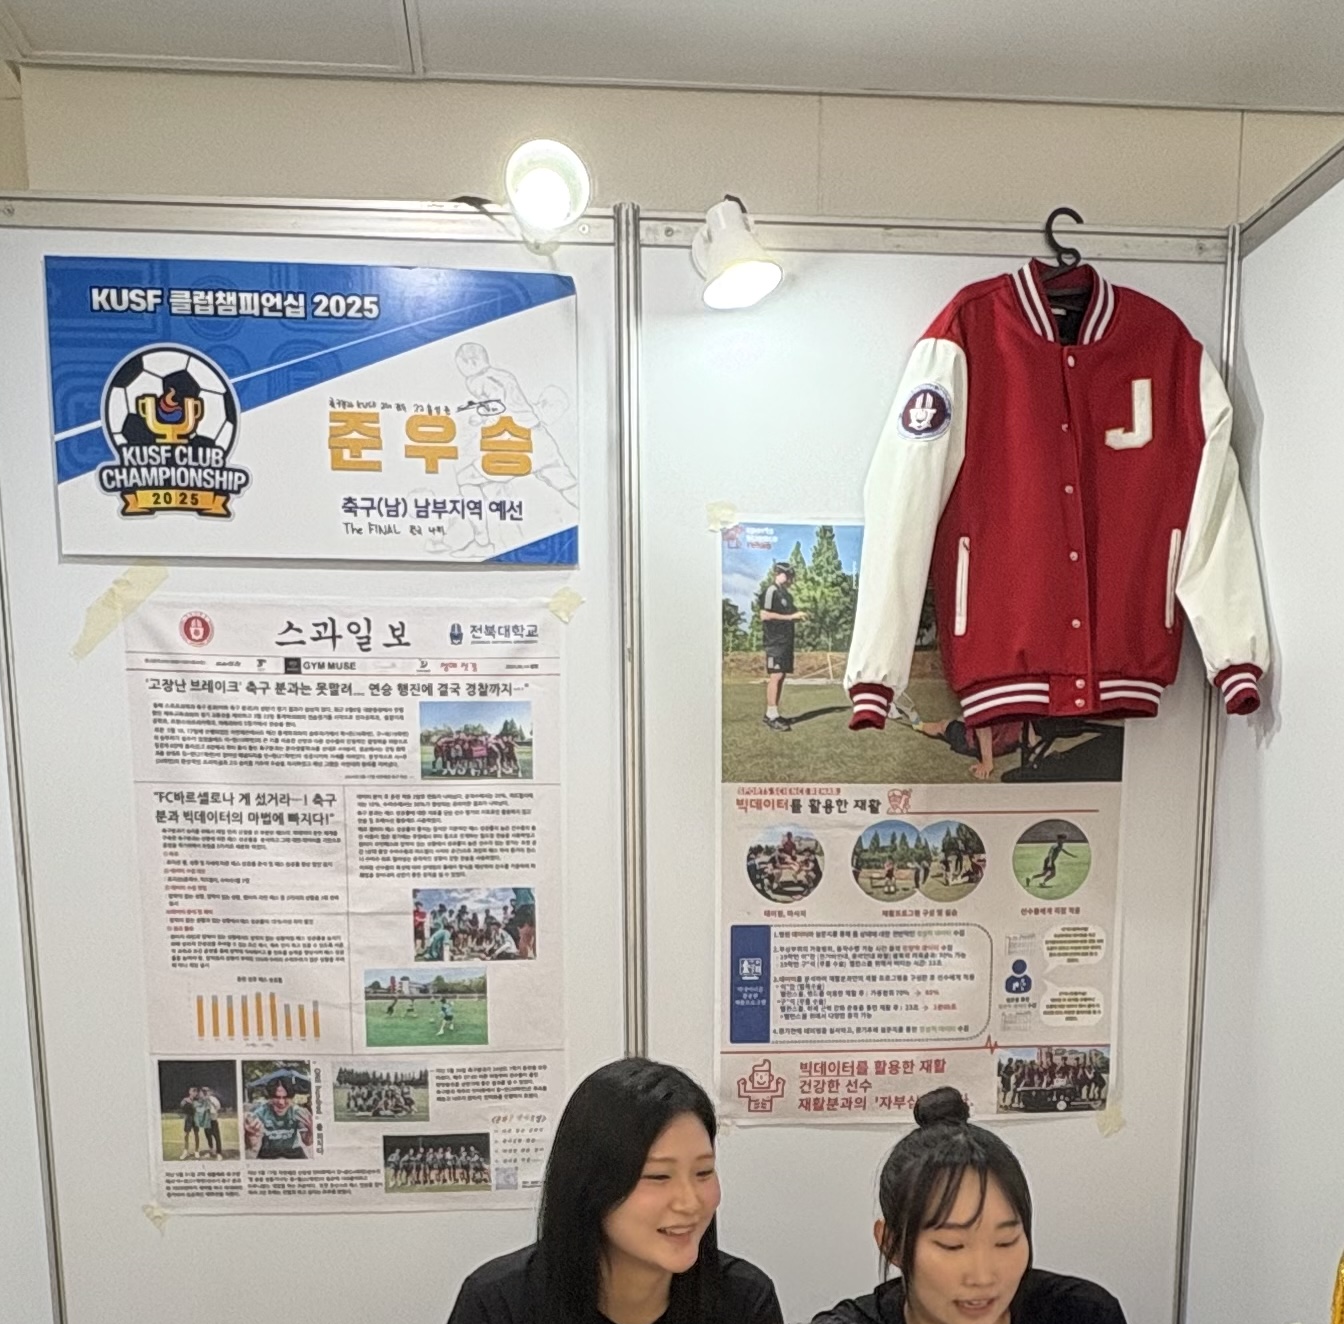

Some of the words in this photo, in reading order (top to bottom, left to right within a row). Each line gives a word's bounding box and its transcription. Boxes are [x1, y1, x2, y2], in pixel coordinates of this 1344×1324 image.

[91, 288, 162, 311] KUSF
[169, 290, 306, 318] 클럽챔피언십
[313, 294, 380, 319] 2025
[1105, 378, 1153, 450] J
[122, 445, 173, 467] KUSF
[174, 445, 224, 468] CLUB
[102, 467, 249, 491] CHAMPIONSHIP
[342, 496, 407, 518] 축구(남)
[414, 498, 483, 520] 남부지역
[488, 500, 523, 521] 예선
[343, 522, 364, 536] The
[368, 523, 401, 536] FINAL
[470, 624, 539, 639] 전북대학교
[303, 661, 325, 670] GYM
[327, 662, 357, 670] MUSE
[368, 683, 393, 697] 연승
[437, 683, 461, 698] 결국
[736, 798, 803, 814] 빅데이터를
[808, 798, 848, 814] 활용한
[853, 798, 882, 814] 재활
[183, 810, 243, 825] 빅데이터의
[799, 1060, 869, 1076] 빅데이터를
[874, 1059, 915, 1075] 활용한
[919, 1058, 946, 1074] 재활
[799, 1079, 840, 1094] 건강한
[845, 1078, 872, 1093] 선수
[798, 1095, 866, 1112] 재활분과의
